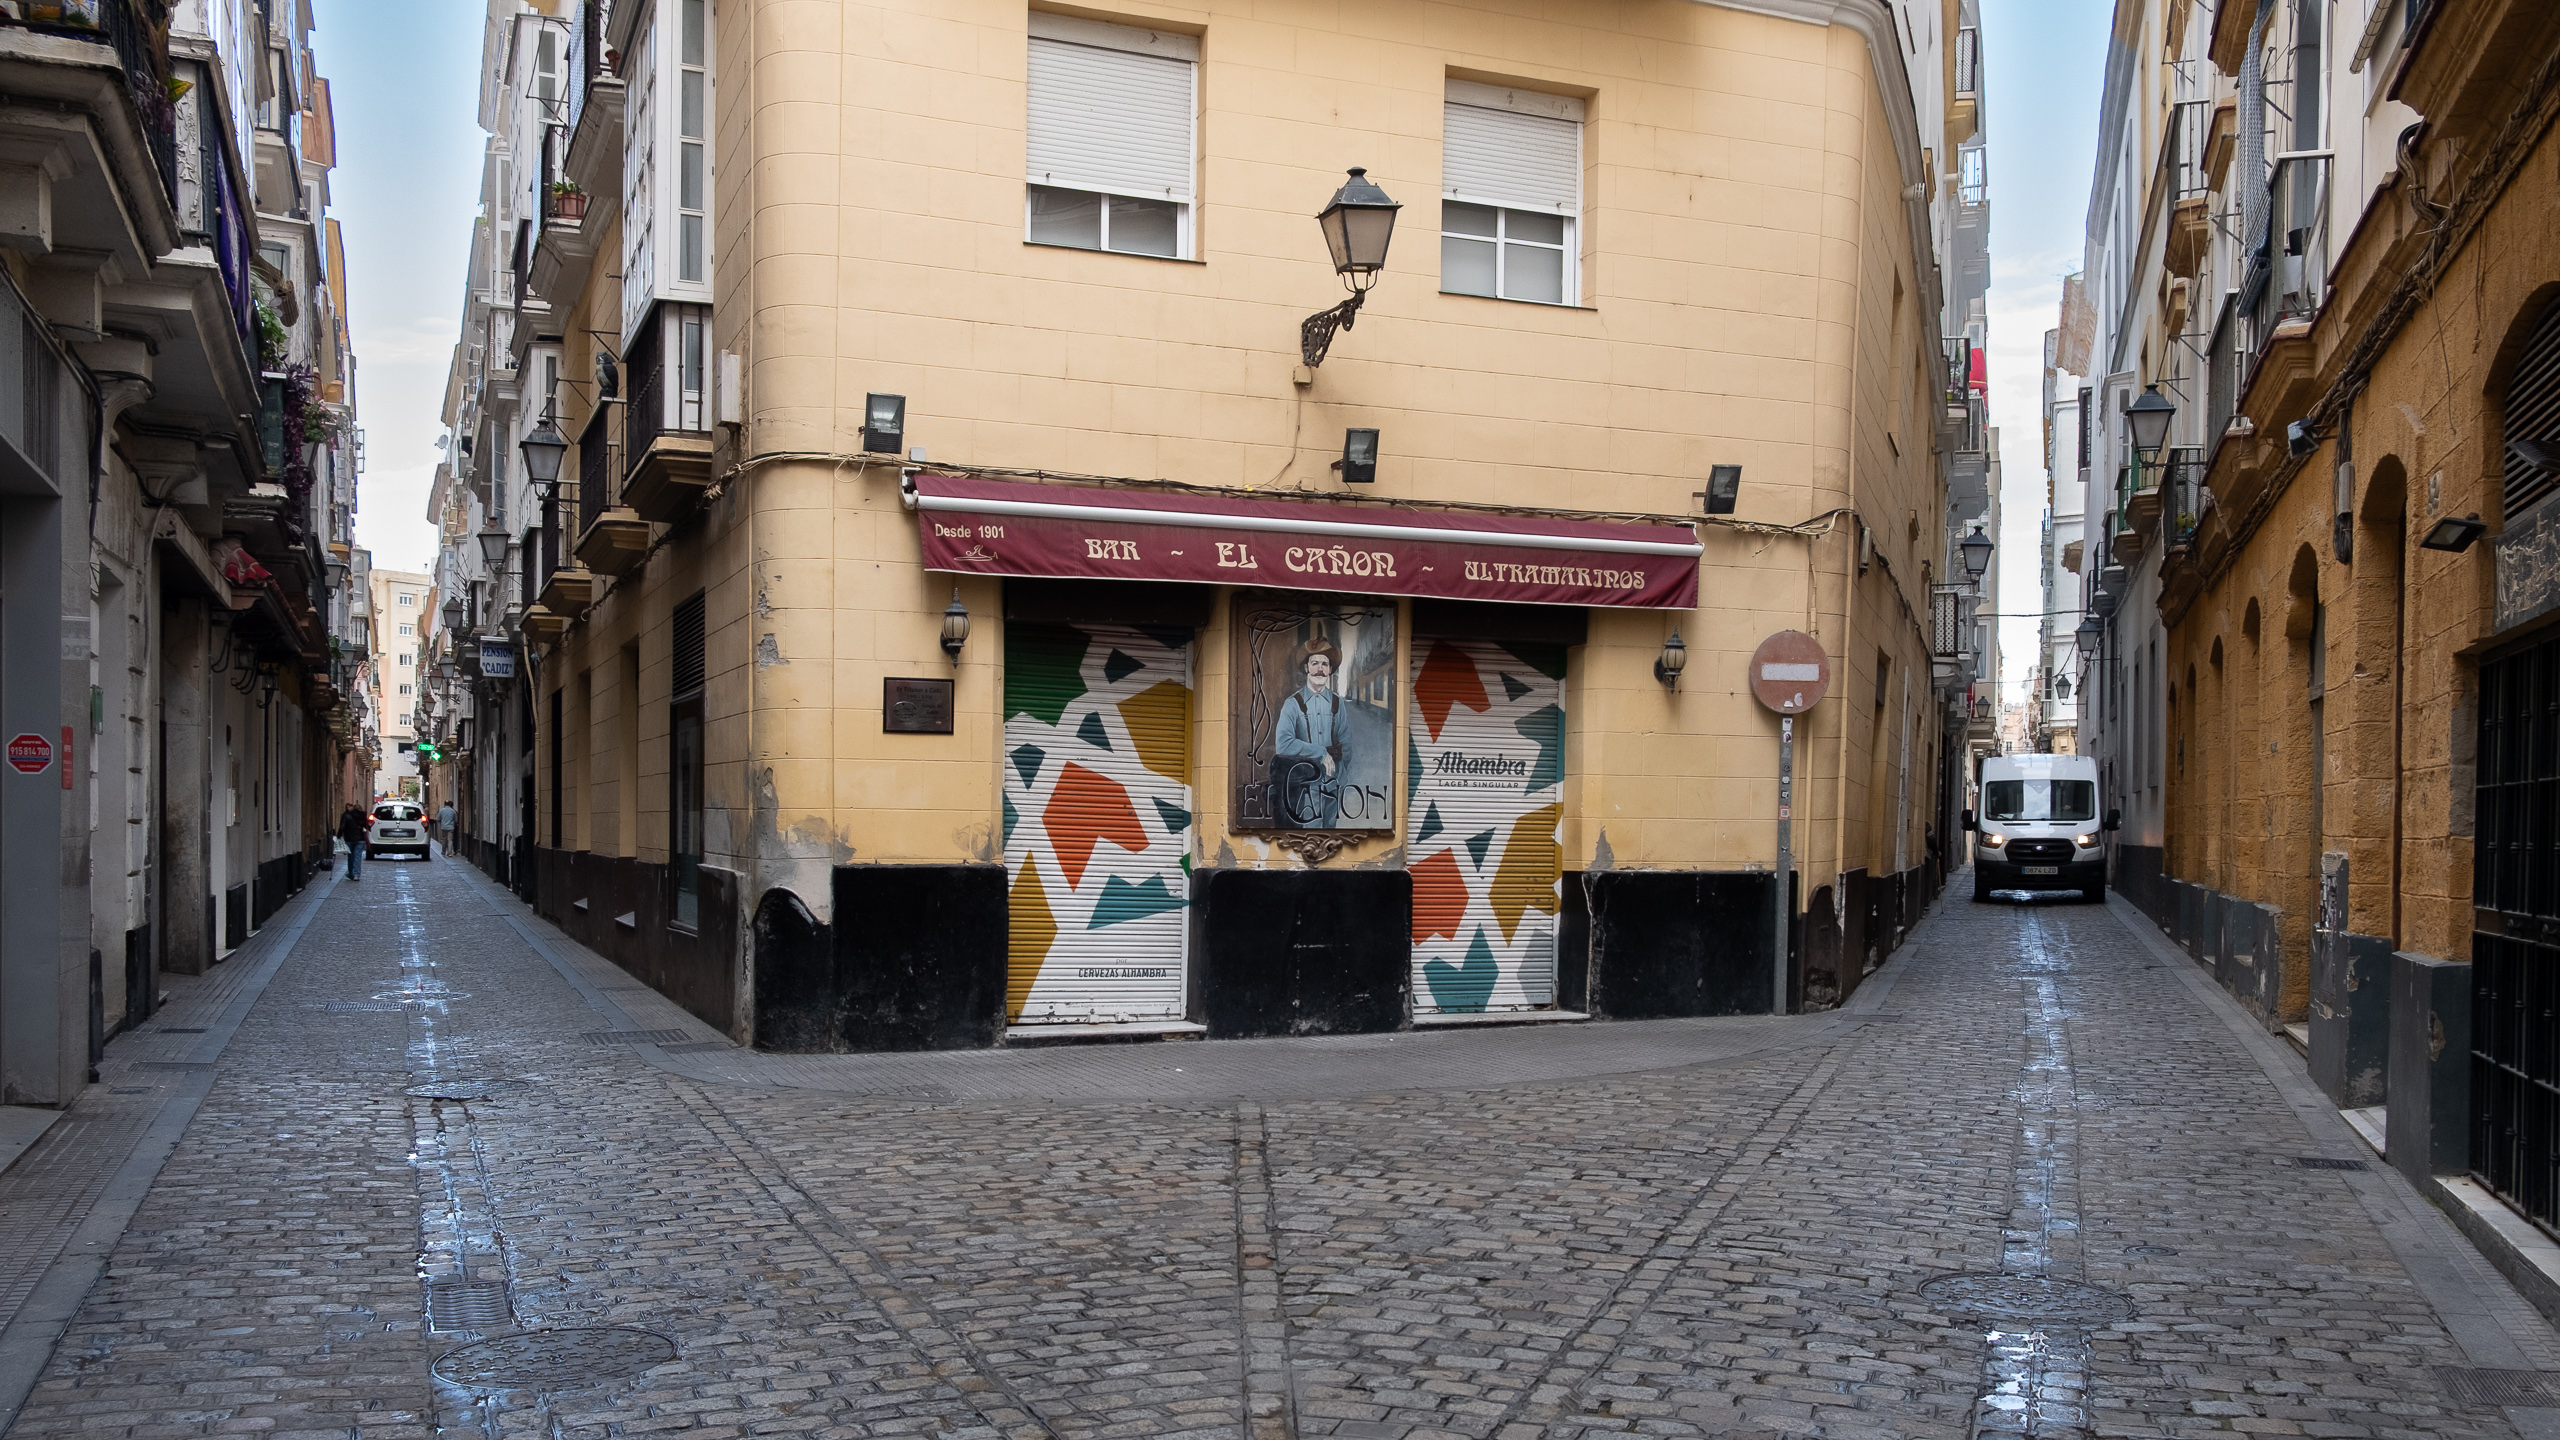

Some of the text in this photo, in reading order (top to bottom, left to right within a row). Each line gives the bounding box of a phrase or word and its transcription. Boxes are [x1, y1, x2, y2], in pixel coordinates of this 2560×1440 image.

[935, 523, 1005, 539] Desde 1901
[1084, 538, 1646, 590] BAR EL CAÑON ULTRAMARINOS
[481, 646, 514, 659] PENSION
[10, 746, 50, 756] 915 814 700
[1432, 751, 1527, 776] Alhambra
[1439, 780, 1519, 789] LAGER SINGULAR
[1078, 968, 1167, 978] CERVEZAS ALHAMBRA
